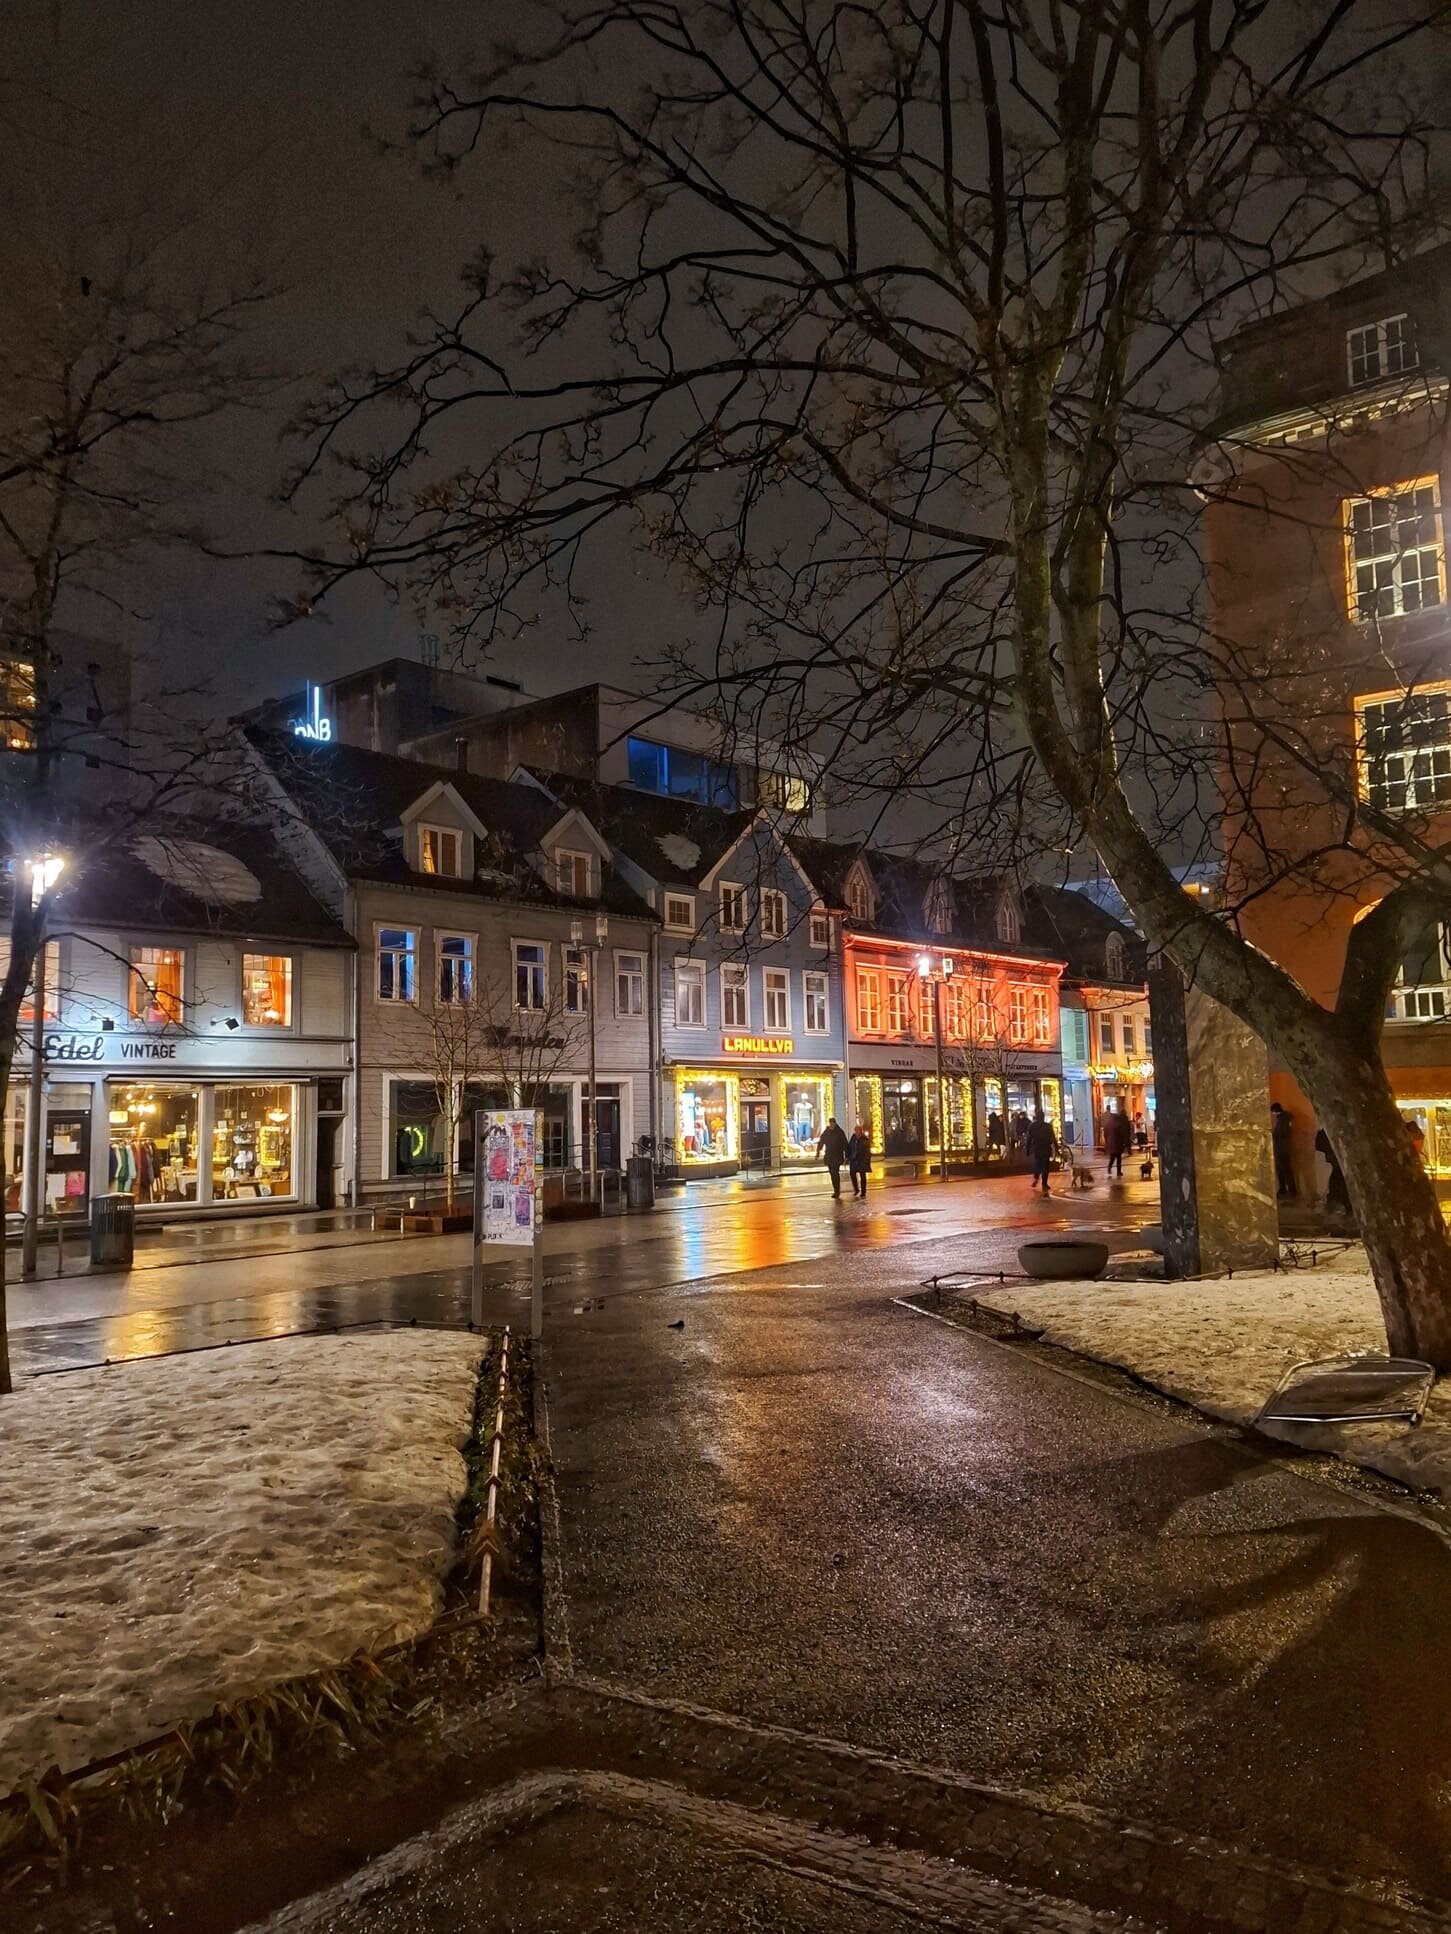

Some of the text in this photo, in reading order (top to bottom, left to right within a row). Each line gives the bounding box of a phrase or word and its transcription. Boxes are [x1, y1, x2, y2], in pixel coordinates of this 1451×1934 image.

[43, 1034, 105, 1061] Edel
[120, 1043, 177, 1059] VINTAGE
[723, 1037, 794, 1054] LANULLVA
